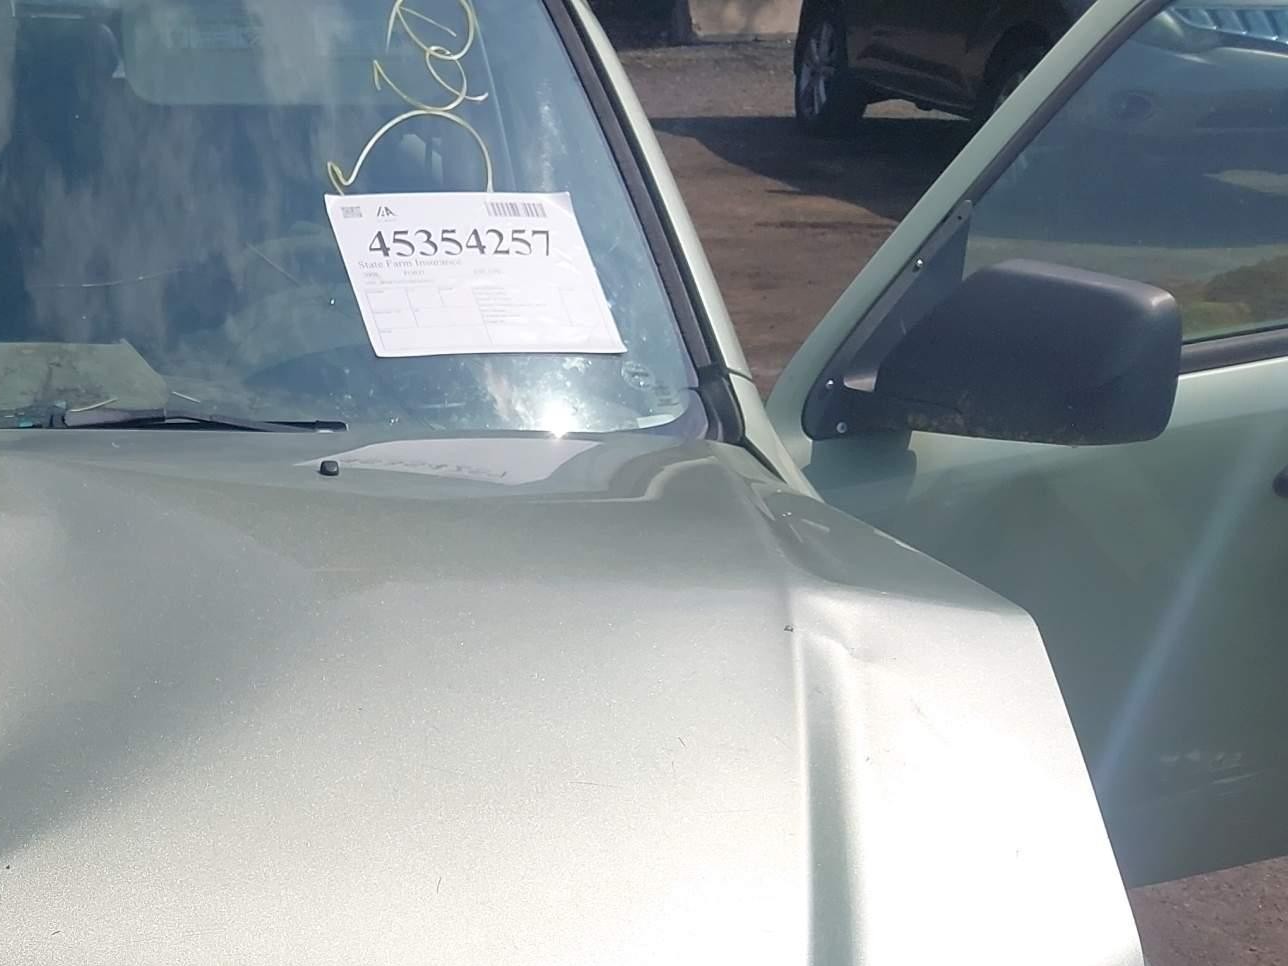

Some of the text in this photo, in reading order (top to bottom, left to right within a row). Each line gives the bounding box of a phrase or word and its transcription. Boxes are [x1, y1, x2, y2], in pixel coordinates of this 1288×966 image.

[369, 228, 550, 257] 45354257
[358, 260, 384, 269] State
[387, 259, 413, 268] Farm
